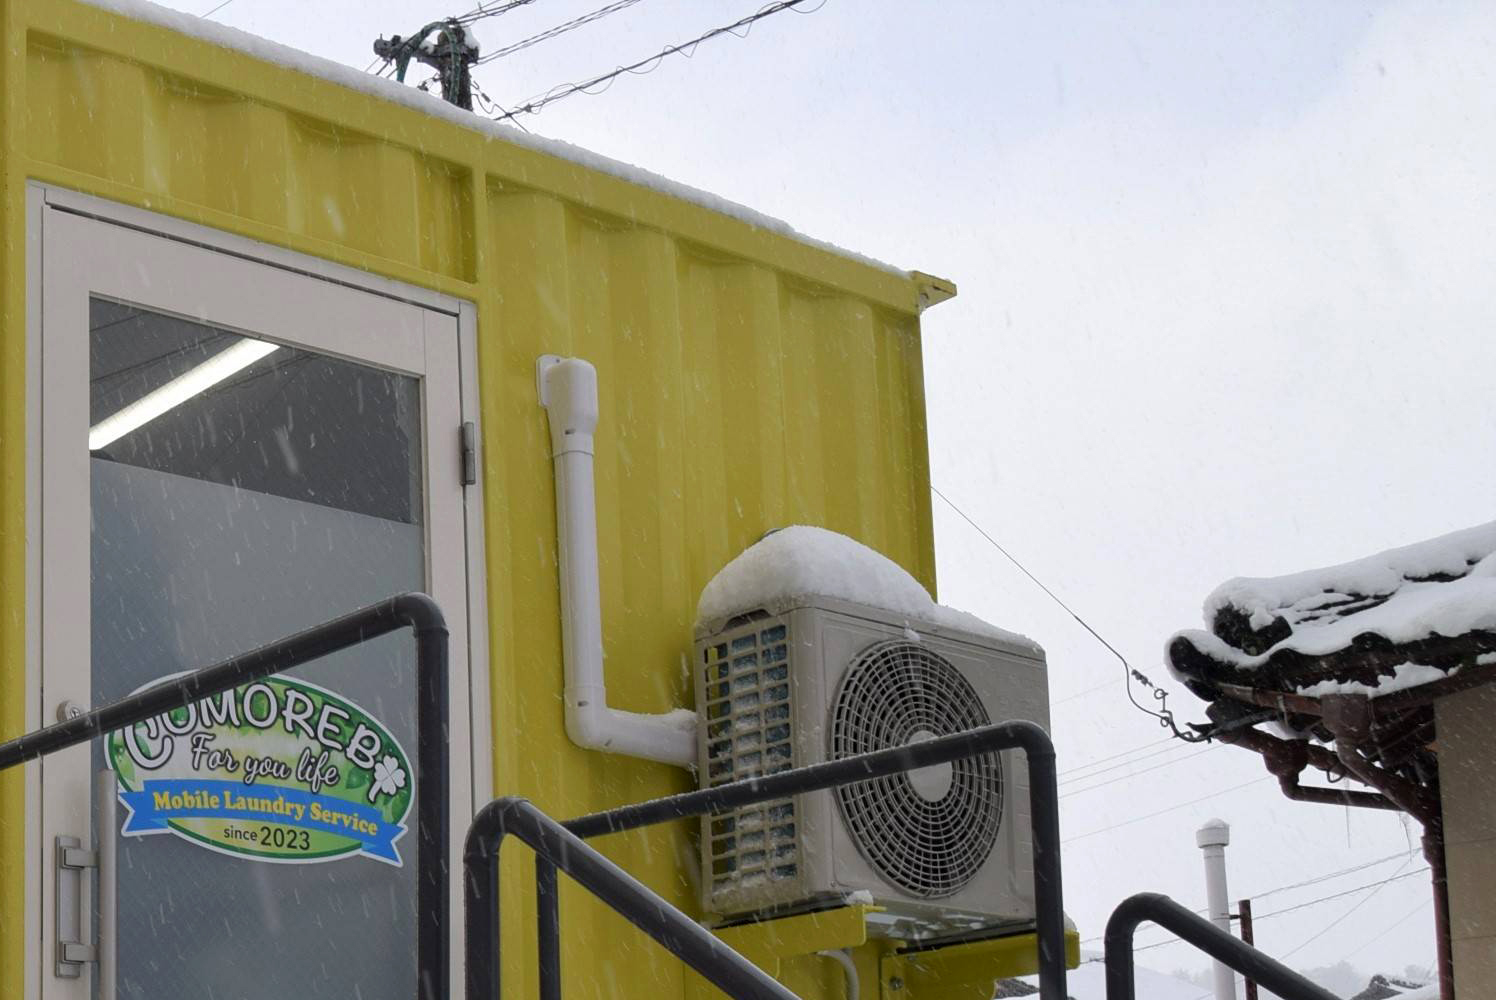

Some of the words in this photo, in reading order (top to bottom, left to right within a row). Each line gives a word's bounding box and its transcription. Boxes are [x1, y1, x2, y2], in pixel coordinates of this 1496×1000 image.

[191, 732, 239, 773] For
[242, 752, 292, 786] you
[295, 747, 341, 794] life
[152, 790, 221, 812] Mobile
[223, 794, 307, 822] Laundry
[309, 801, 379, 837] Service
[223, 824, 259, 842] since
[260, 826, 312, 851] 2023
